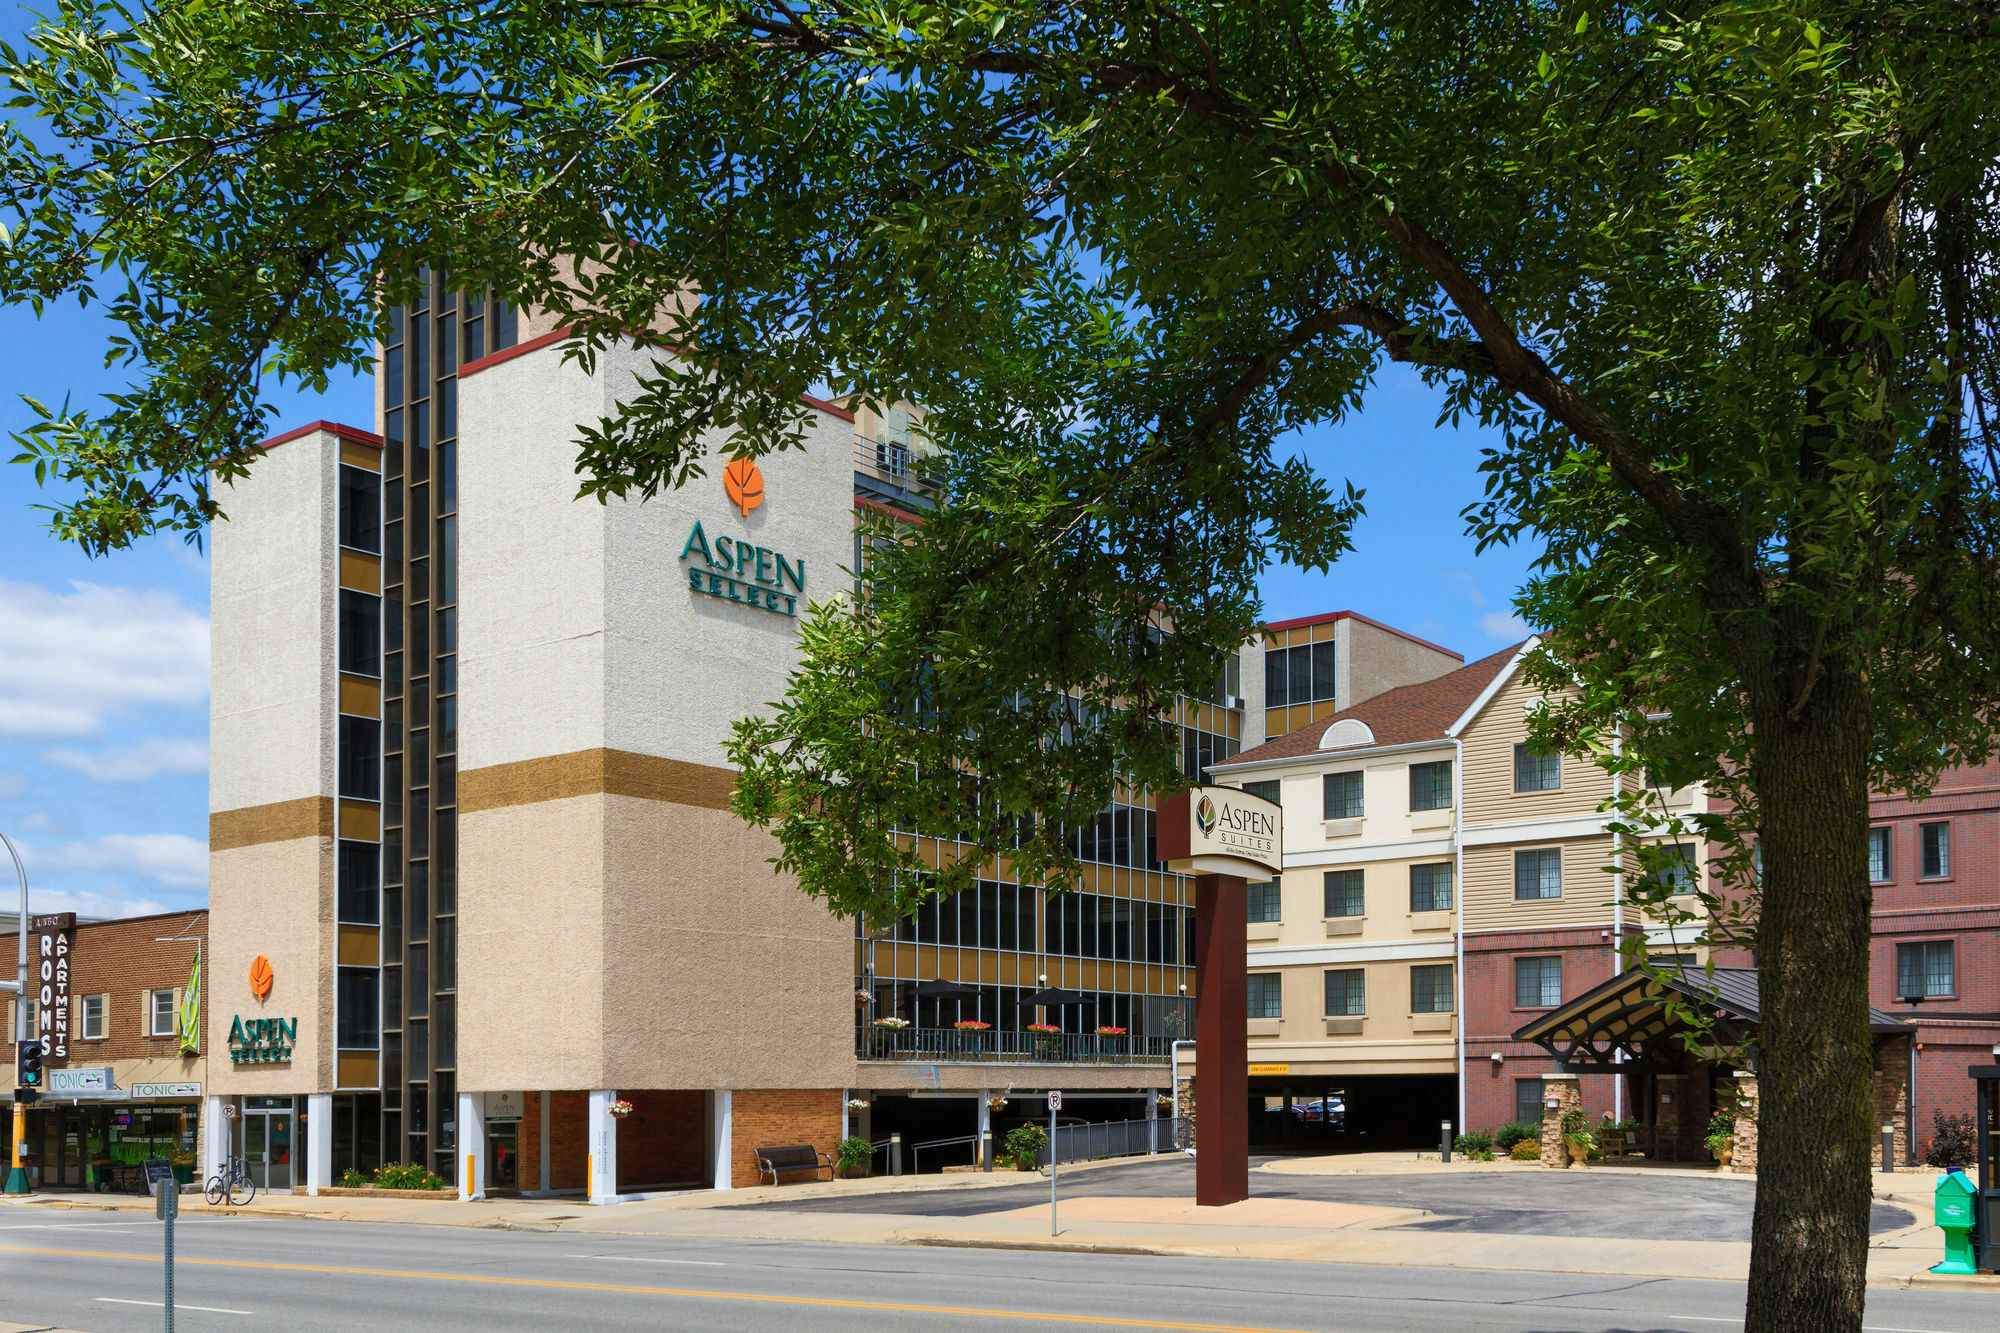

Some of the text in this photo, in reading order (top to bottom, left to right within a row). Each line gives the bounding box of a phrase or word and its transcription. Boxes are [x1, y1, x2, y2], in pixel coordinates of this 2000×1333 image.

[679, 520, 806, 592] ASPEN
[689, 571, 797, 614] SELECT
[1219, 801, 1274, 837] ASPEN
[1221, 832, 1272, 851] SUITES
[41, 935, 52, 1056] ROOMS
[55, 933, 68, 1057] APARTMENTS
[226, 1014, 298, 1044] ASPEN
[230, 1047, 293, 1062] SELECT
[52, 1073, 86, 1089] TONIC
[135, 1084, 176, 1096] TONIC
